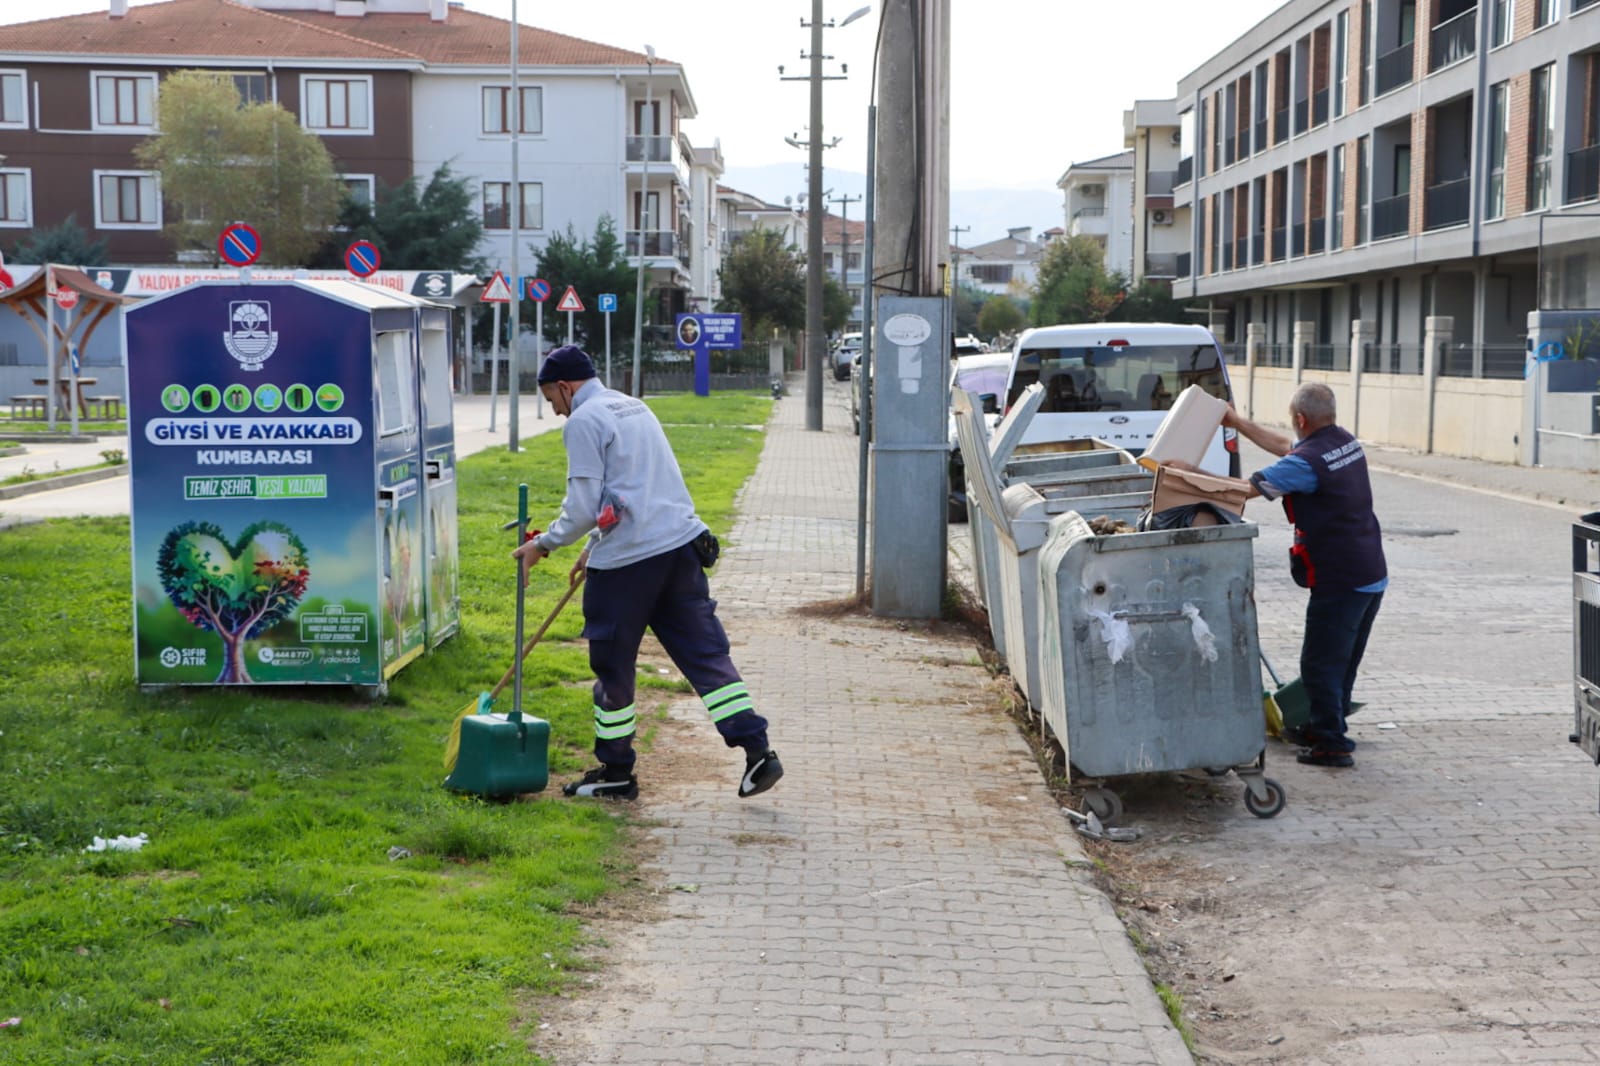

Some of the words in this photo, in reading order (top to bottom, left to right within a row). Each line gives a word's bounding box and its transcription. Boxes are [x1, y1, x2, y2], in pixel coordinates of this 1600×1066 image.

[138, 274, 181, 291] YALOVA
[603, 297, 613, 309] P
[154, 421, 209, 440] GİYSİ
[214, 424, 242, 440] VE
[247, 424, 354, 439] AYAKKABI
[196, 450, 313, 465] KUMBARASI
[189, 478, 218, 497] TEMİZ
[258, 477, 285, 497] YEŞİL
[287, 477, 324, 495] YALOVA
[181, 648, 206, 657] SIFIR
[182, 657, 207, 666] ATIK
